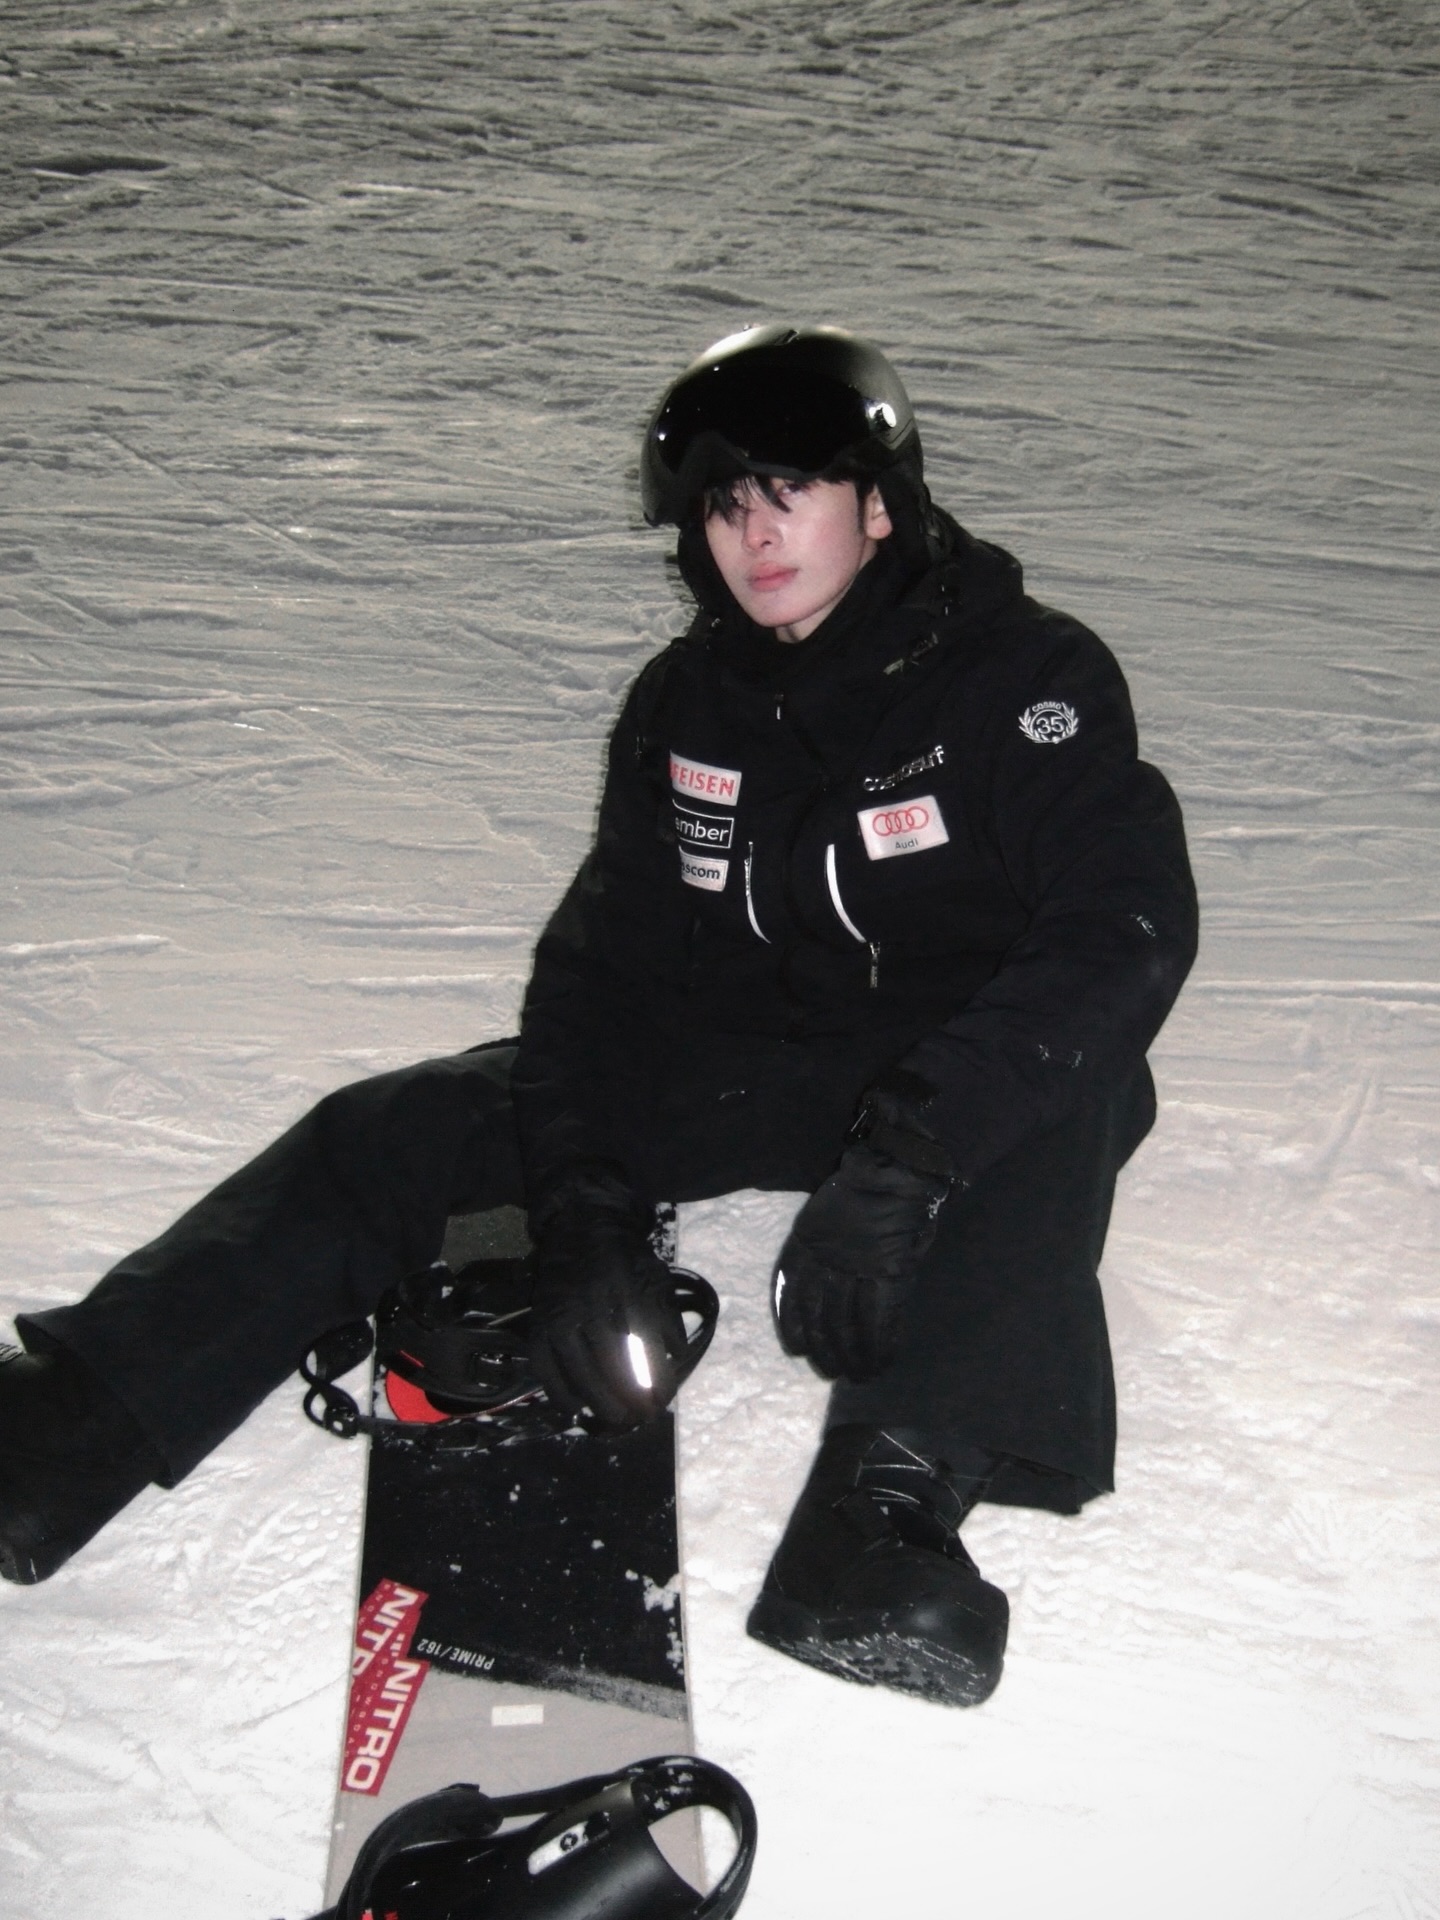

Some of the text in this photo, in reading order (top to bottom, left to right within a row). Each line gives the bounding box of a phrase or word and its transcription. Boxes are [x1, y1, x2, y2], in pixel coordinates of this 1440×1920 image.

[1036, 716, 1064, 734] 35
[668, 758, 735, 797] FEISEN
[895, 838, 919, 850] Audi
[417, 1638, 495, 1670] PRIME/162
[346, 1660, 421, 1790] NITRO
